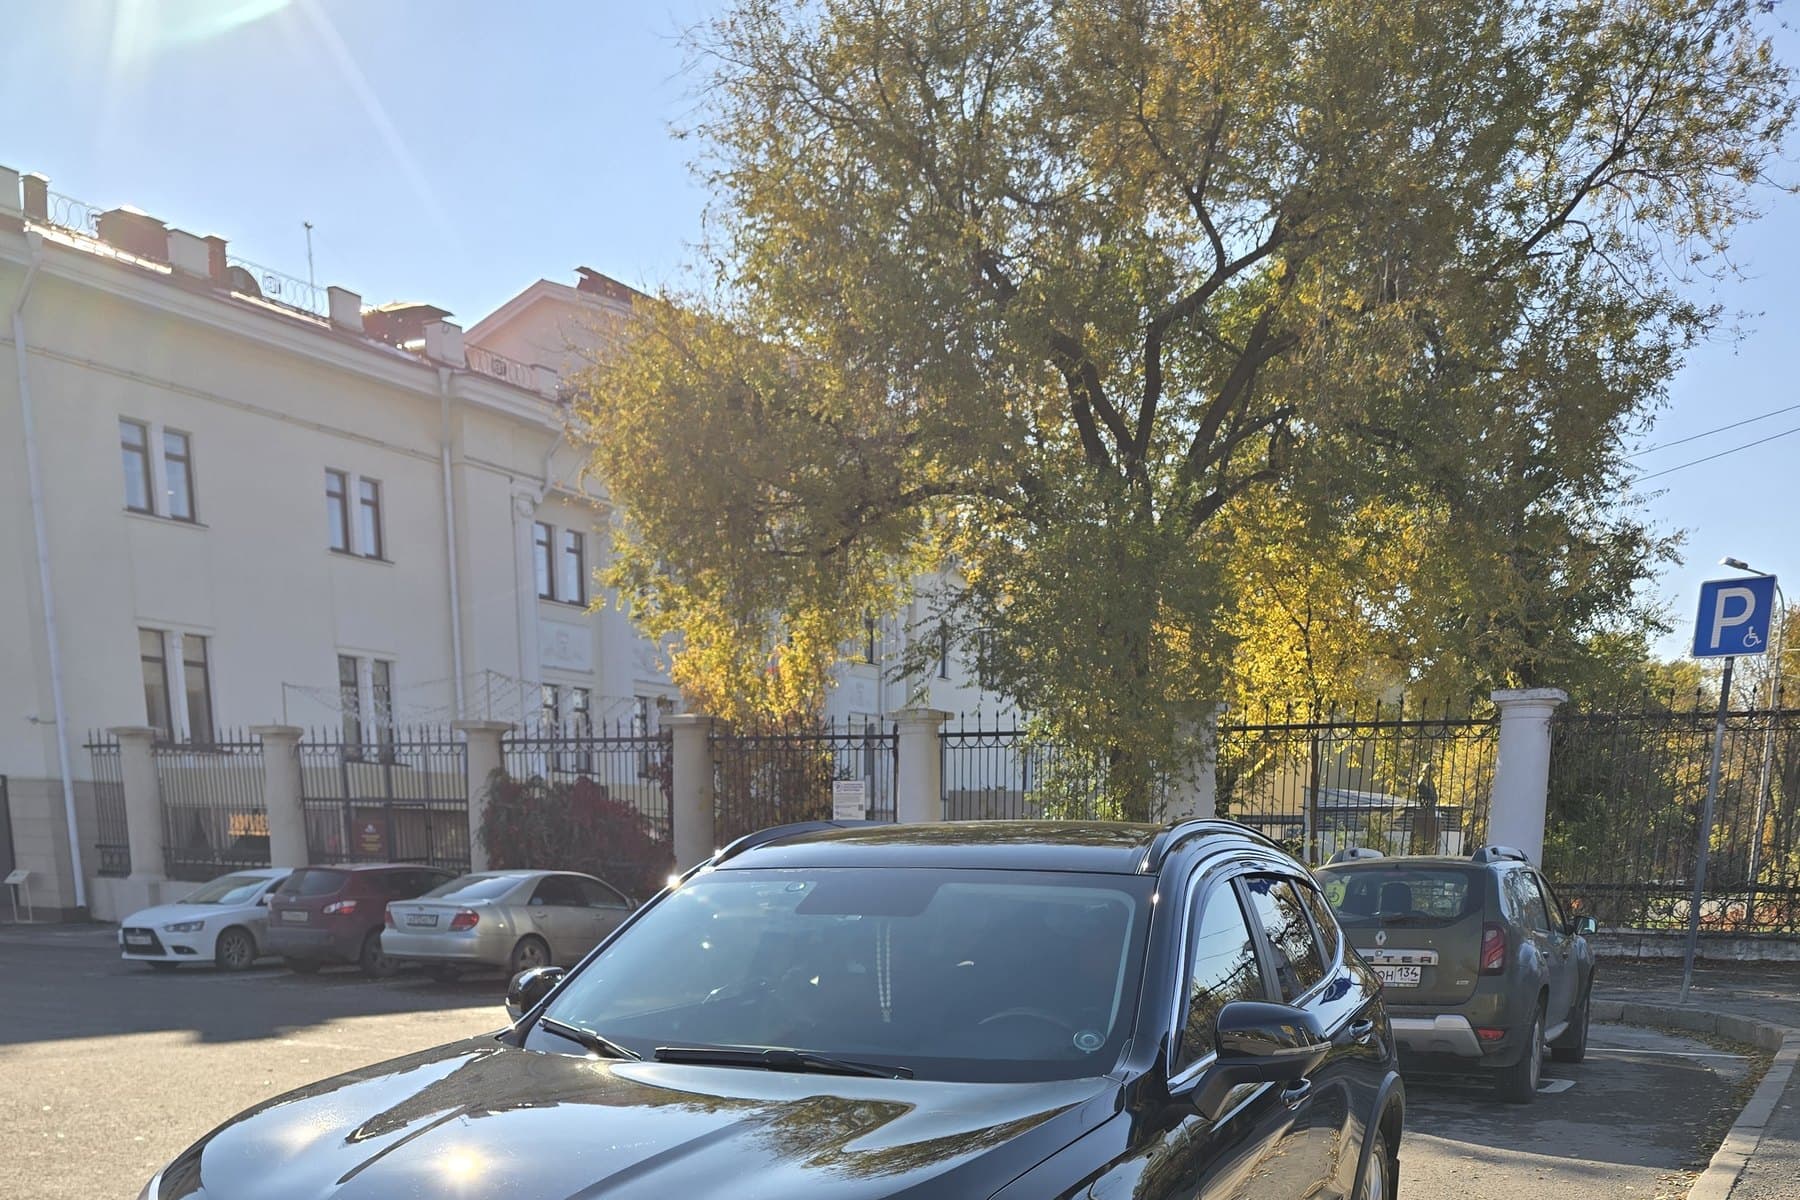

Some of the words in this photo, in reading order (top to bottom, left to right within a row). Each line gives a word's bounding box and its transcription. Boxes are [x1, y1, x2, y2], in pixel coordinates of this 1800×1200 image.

[1710, 587, 1756, 648] P
[1363, 955, 1432, 963] STER
[1397, 967, 1419, 978] 134
